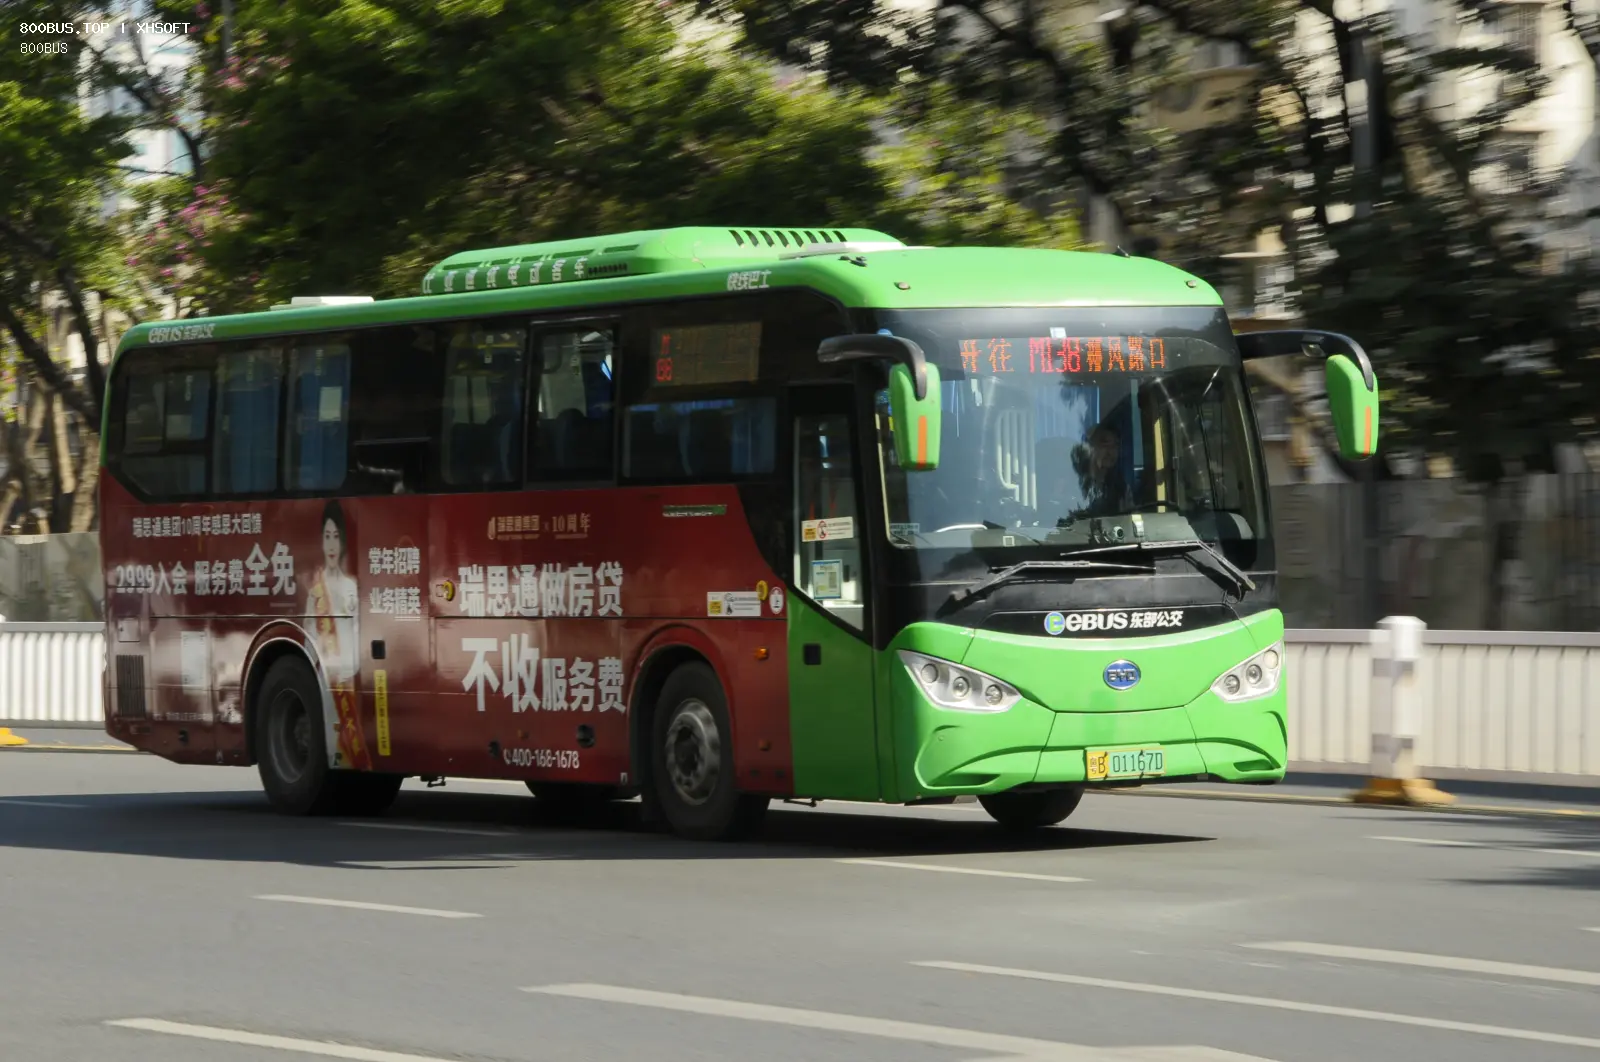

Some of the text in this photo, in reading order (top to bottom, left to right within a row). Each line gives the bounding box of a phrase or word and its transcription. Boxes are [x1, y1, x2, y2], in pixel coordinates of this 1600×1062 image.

[194, 543, 297, 596] 服务费全免
[368, 546, 420, 576] 常年招聘
[369, 586, 421, 615] 业务精英
[458, 562, 624, 617] 瑞思通做房贷
[1129, 611, 1184, 629] 东部公交
[461, 633, 627, 714] 不收服务费
[511, 750, 580, 769] 400-168-1678
[1112, 752, 1163, 773] 01167D
